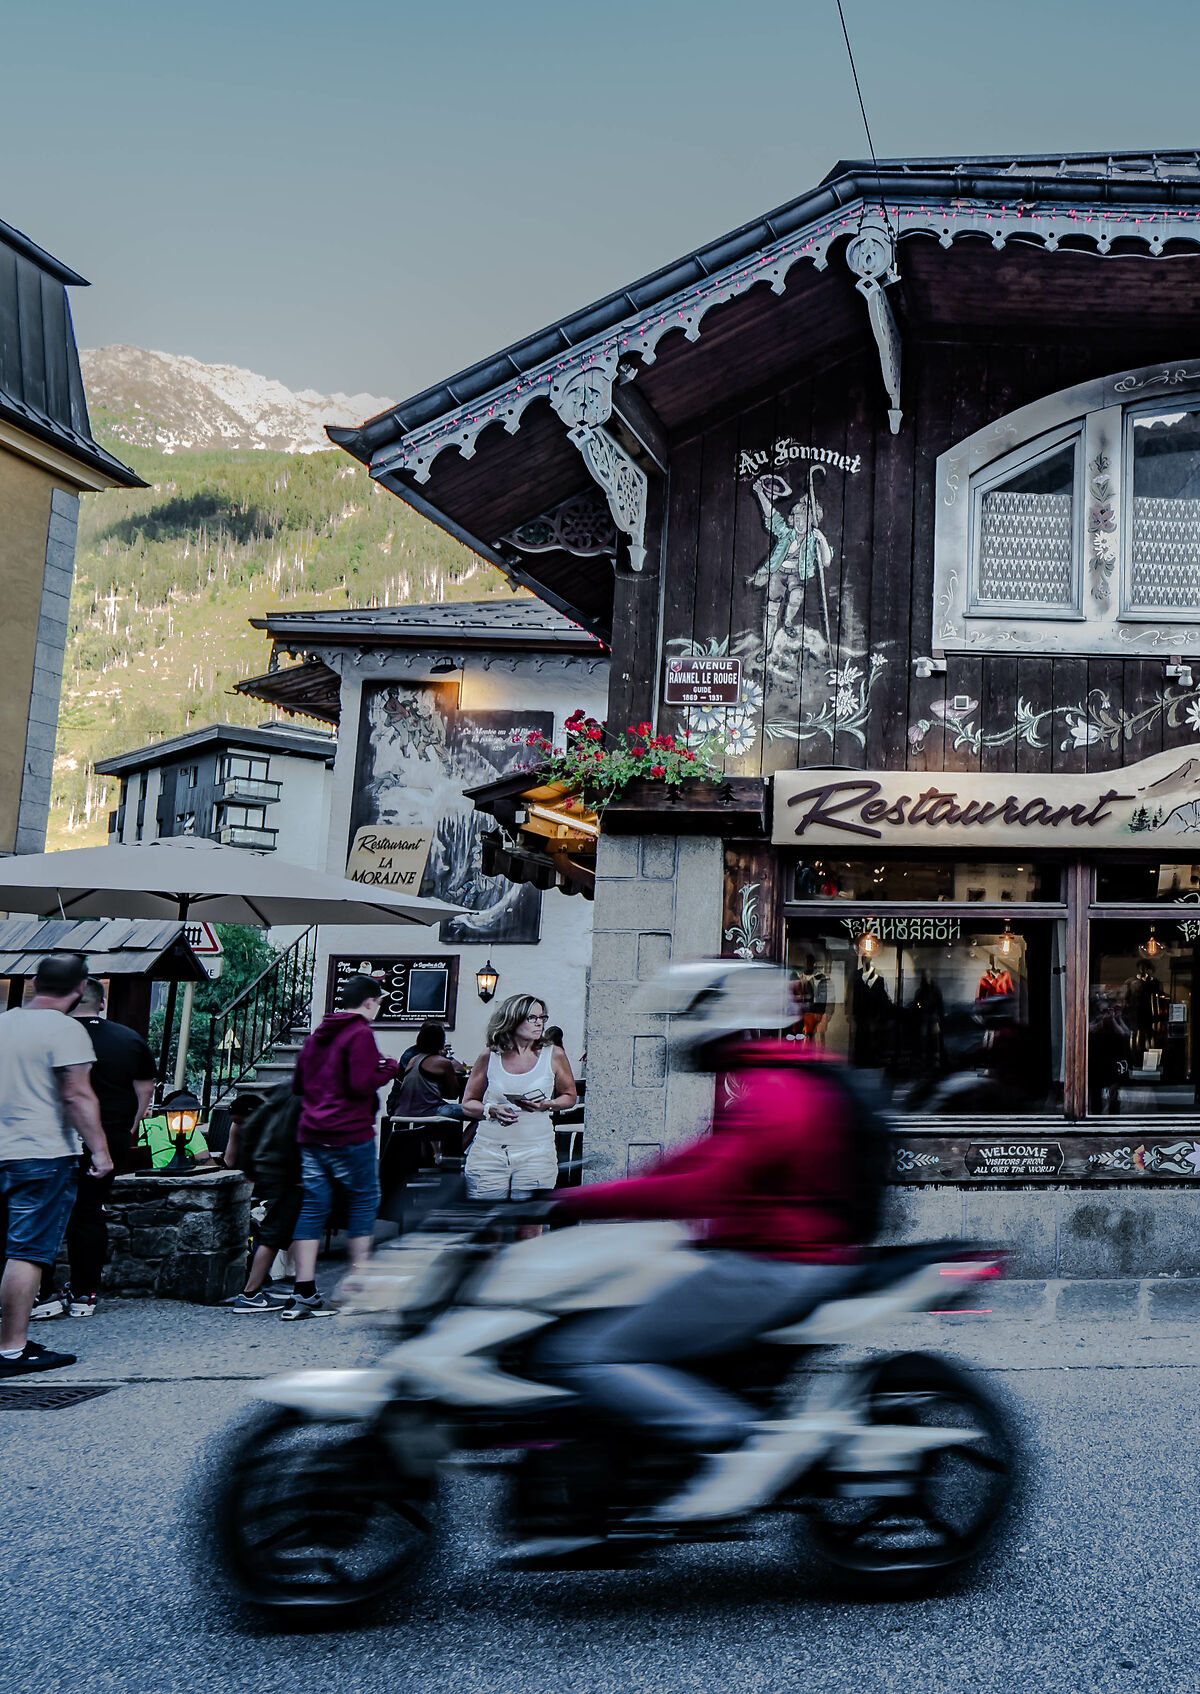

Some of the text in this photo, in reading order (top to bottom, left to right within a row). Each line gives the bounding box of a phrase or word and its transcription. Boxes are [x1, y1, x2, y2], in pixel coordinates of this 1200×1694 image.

[739, 437, 861, 475] Au Sommet
[691, 661, 733, 671] AVENUE
[669, 671, 738, 684] RAVANEL LE ROUGE
[692, 686, 712, 694] GUIDE
[787, 779, 1136, 838] Restaurant
[357, 834, 426, 854] Restaurant
[378, 857, 393, 869] LA
[351, 869, 417, 885] MORAINE
[979, 1145, 1049, 1159] WELCOME
[985, 1158, 1045, 1166] VISITORS FROM
[973, 1166, 989, 1174] ALL
[990, 1166, 1010, 1174] OVER
[1027, 1165, 1056, 1173] WORLD
